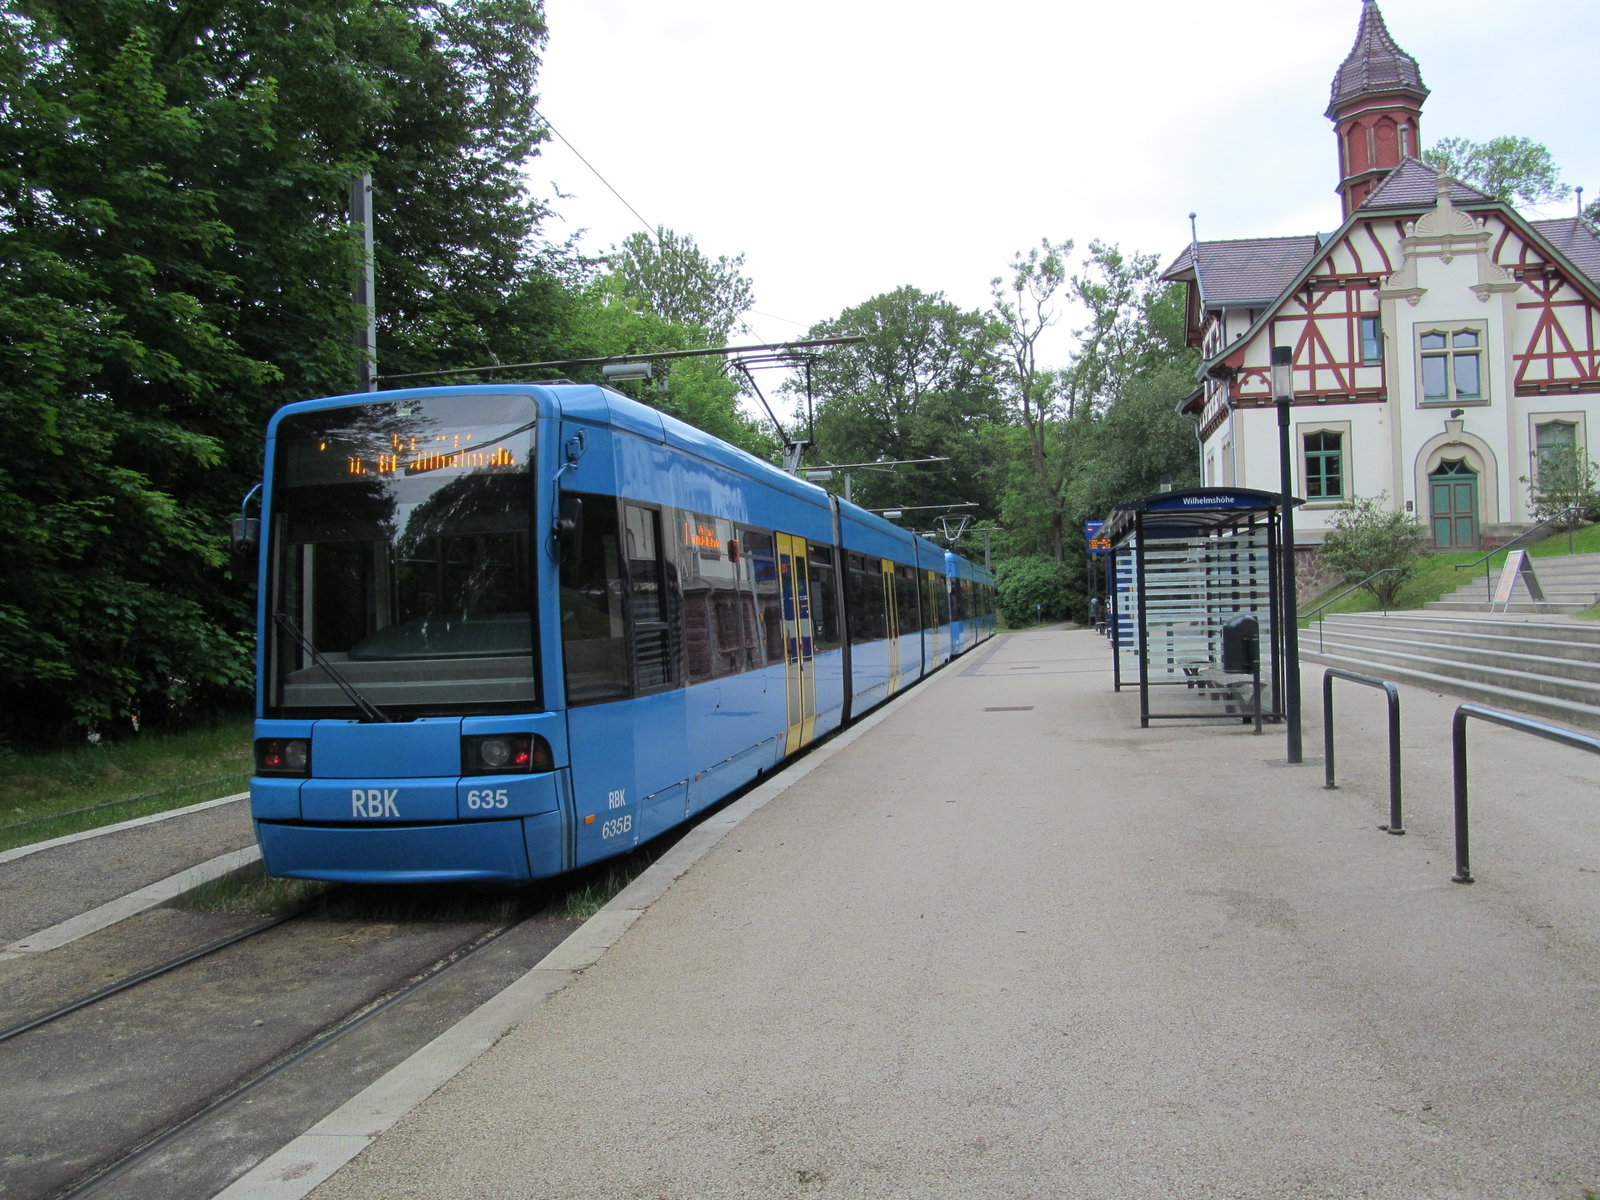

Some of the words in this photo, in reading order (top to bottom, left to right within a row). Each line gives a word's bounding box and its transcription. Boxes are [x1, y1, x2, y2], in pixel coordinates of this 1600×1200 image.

[1182, 496, 1236, 505] Wilhelmshöhe
[351, 789, 401, 818] RBK
[467, 789, 509, 810] 635
[608, 788, 626, 810] RBK
[602, 814, 632, 840] 635B
